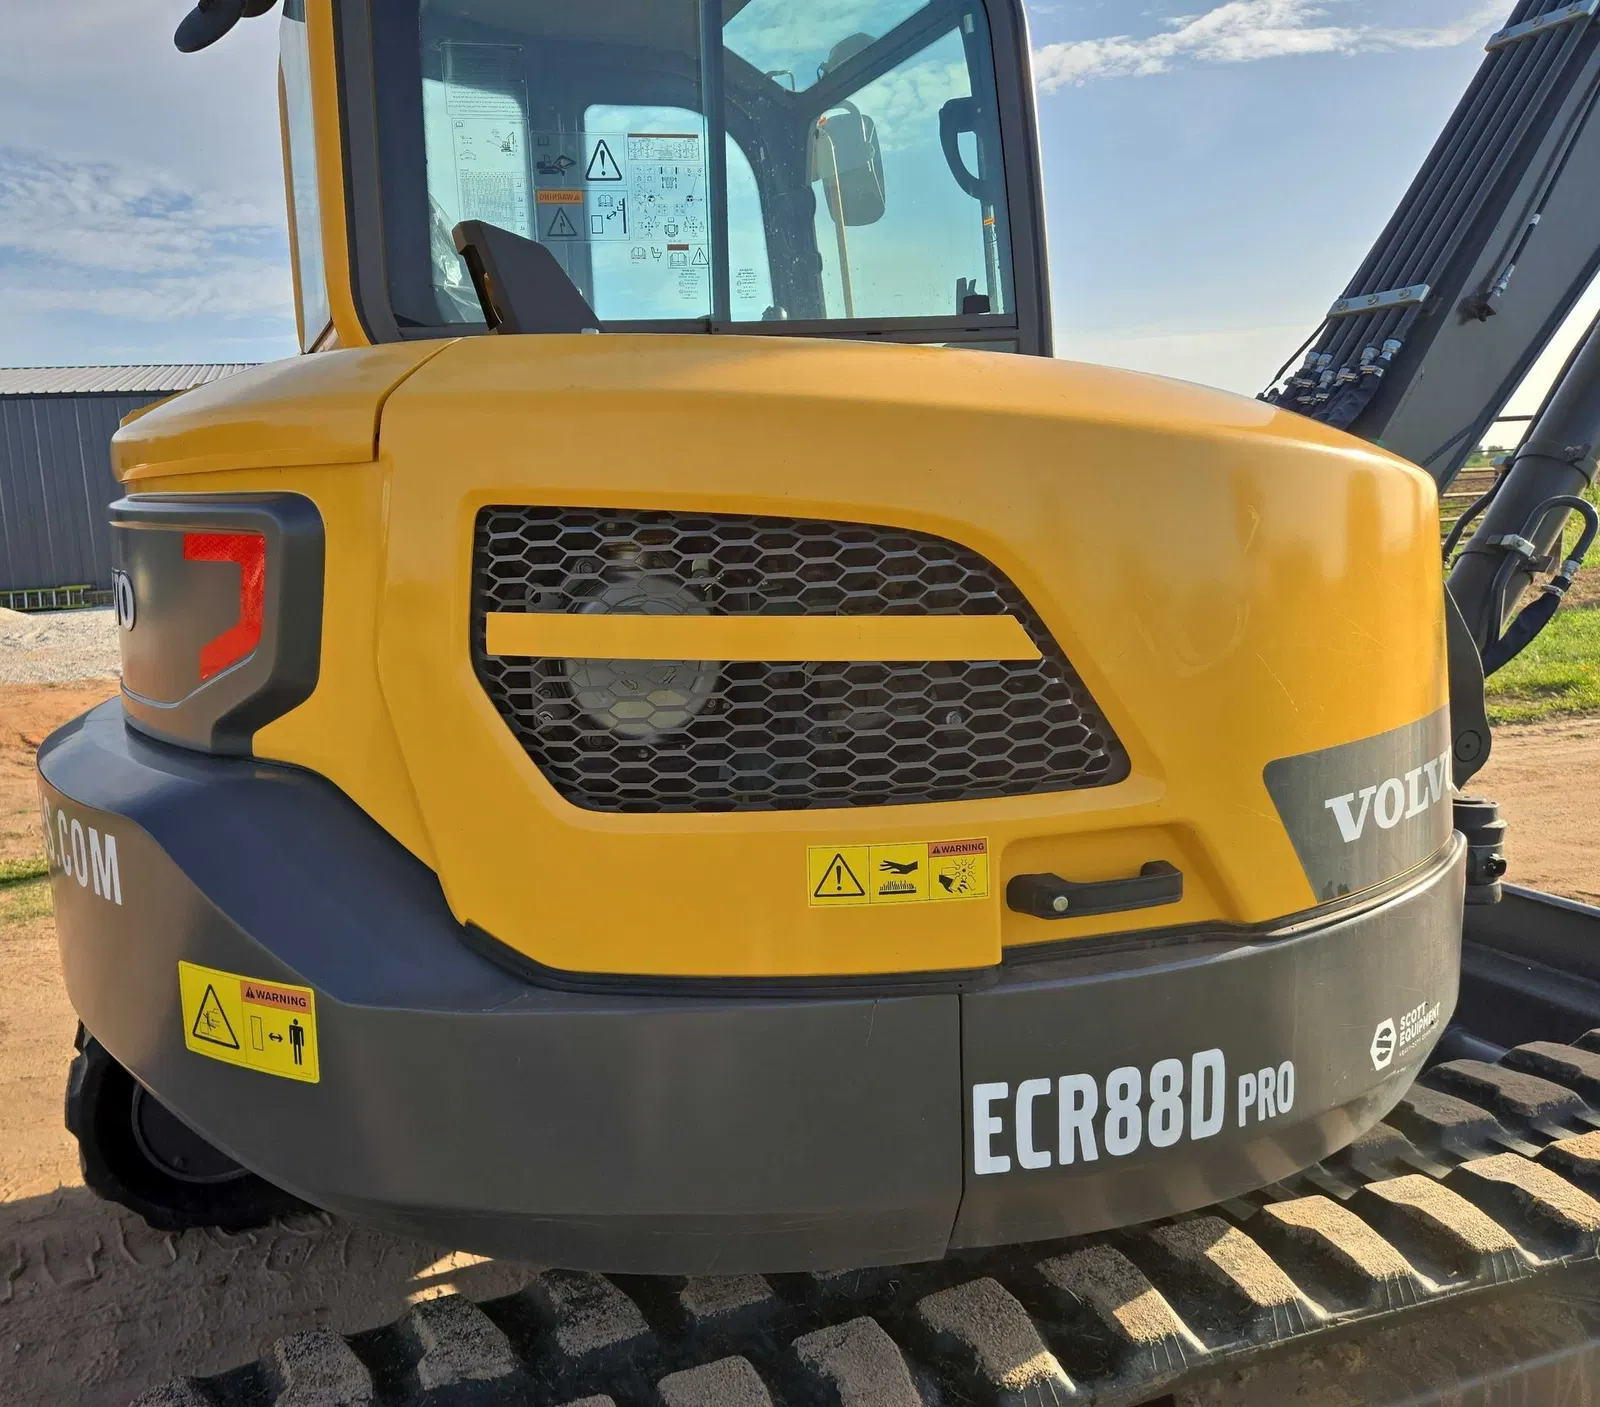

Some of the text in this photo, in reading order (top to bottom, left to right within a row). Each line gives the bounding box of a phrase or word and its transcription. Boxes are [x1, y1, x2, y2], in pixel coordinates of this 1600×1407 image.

[941, 842, 985, 854] WARNING
[255, 989, 307, 1008] WARNING
[1399, 1001, 1441, 1047] EQUIPMENT
[1400, 1001, 1427, 1031] SCOTT
[972, 1048, 1295, 1176] ECR88D PRO
